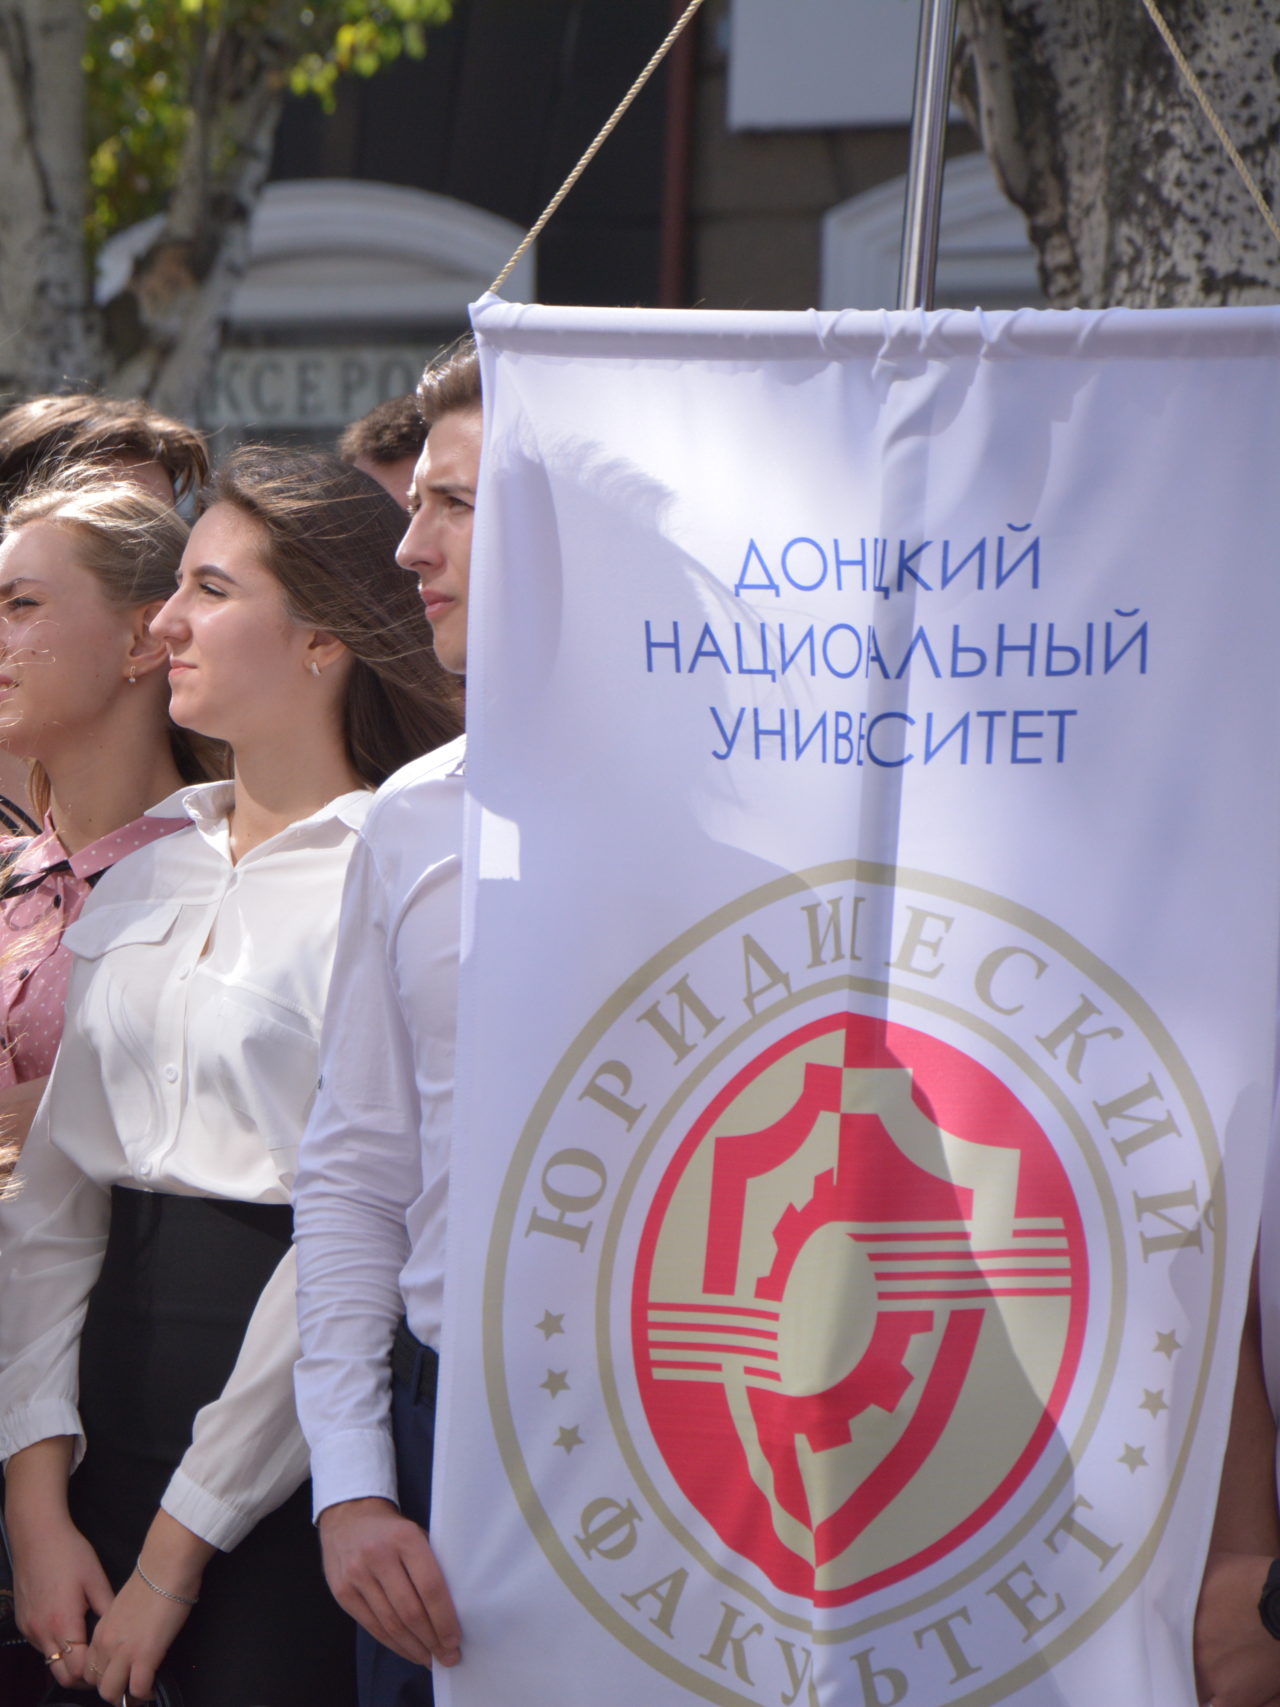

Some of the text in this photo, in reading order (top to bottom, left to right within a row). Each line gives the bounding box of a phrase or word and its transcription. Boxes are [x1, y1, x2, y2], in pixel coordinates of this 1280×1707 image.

[734, 522, 1041, 600] ДОНЦКИЙ
[644, 608, 1149, 682] НАЦИОАЛЬНЫЙ
[708, 706, 1078, 768] УНИВЕСИТЕТ
[525, 896, 1216, 1263] ЮРИДИЕСКИЙ
[572, 1494, 1125, 1707] ФАКУЬТЕТ
